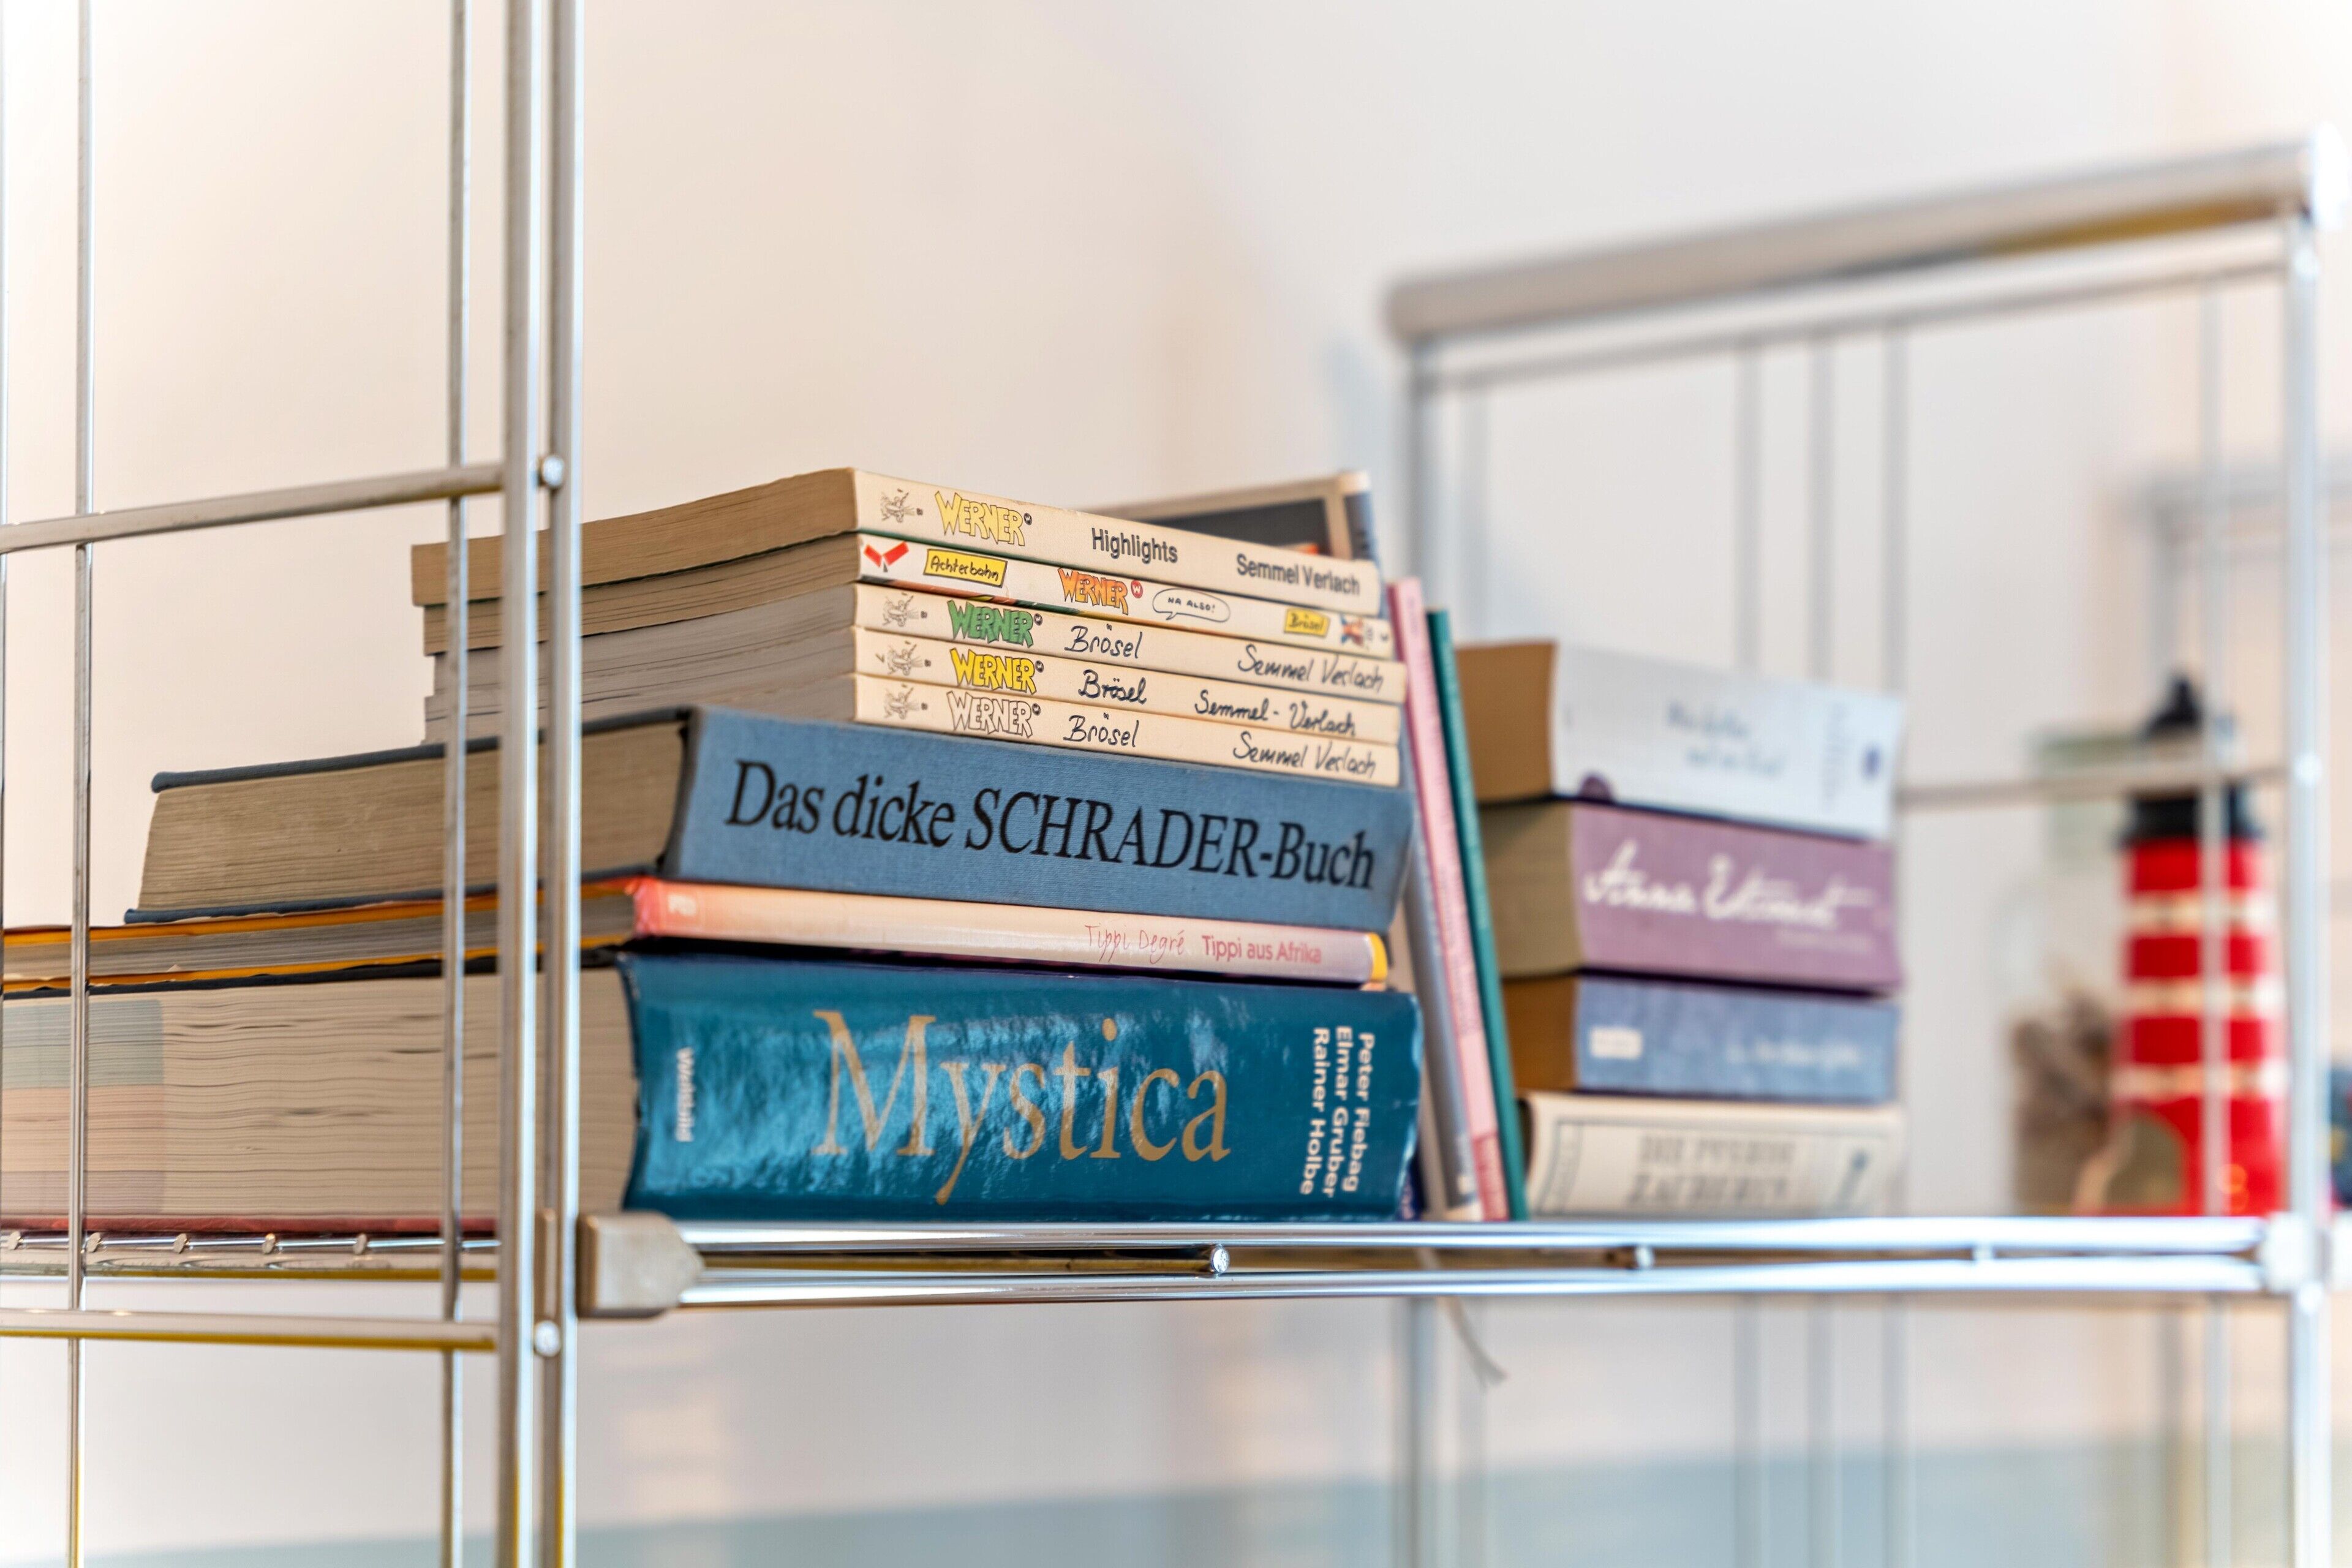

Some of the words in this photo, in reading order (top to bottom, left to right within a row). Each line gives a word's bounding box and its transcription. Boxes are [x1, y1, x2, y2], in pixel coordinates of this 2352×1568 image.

[930, 556, 1000, 581] Achterbahn
[935, 491, 1025, 546] WERNER
[1091, 528, 1178, 565] Highlights
[1237, 553, 1299, 584] Semmel
[1302, 565, 1360, 596] Verlach
[1058, 567, 1128, 616] WERNER
[1168, 597, 1182, 606] NA
[1186, 600, 1215, 613] ALSO!
[948, 600, 1034, 648] WERNER
[1064, 624, 1143, 658] Brösel
[1238, 644, 1313, 681] Semmel
[1321, 652, 1384, 694] Verlach
[946, 691, 1033, 739] WERNER
[1063, 712, 1139, 748] Brösel
[1233, 731, 1306, 767] Semmel
[1314, 740, 1376, 778] Verlach
[949, 647, 1037, 695] WERNER
[1078, 669, 1147, 704] Brösel
[1290, 700, 1356, 737] Verlach
[725, 760, 825, 834] Das
[832, 774, 956, 848] dicke
[965, 787, 1374, 891] SCHRADER-Buch
[1085, 924, 1131, 962] Tippi
[1139, 930, 1185, 965] Degré
[1202, 935, 1242, 962] Tippi
[1247, 942, 1273, 960] aus
[1276, 941, 1322, 964] Afrika
[1312, 1027, 1330, 1112] Rainer
[1335, 1025, 1353, 1101] Elmar
[1355, 1032, 1375, 1101] Peter
[810, 1009, 1232, 1205] Mystica
[1299, 1118, 1327, 1196] Holbe
[1322, 1107, 1349, 1198] Gruber
[1341, 1107, 1371, 1193] Fiebag
